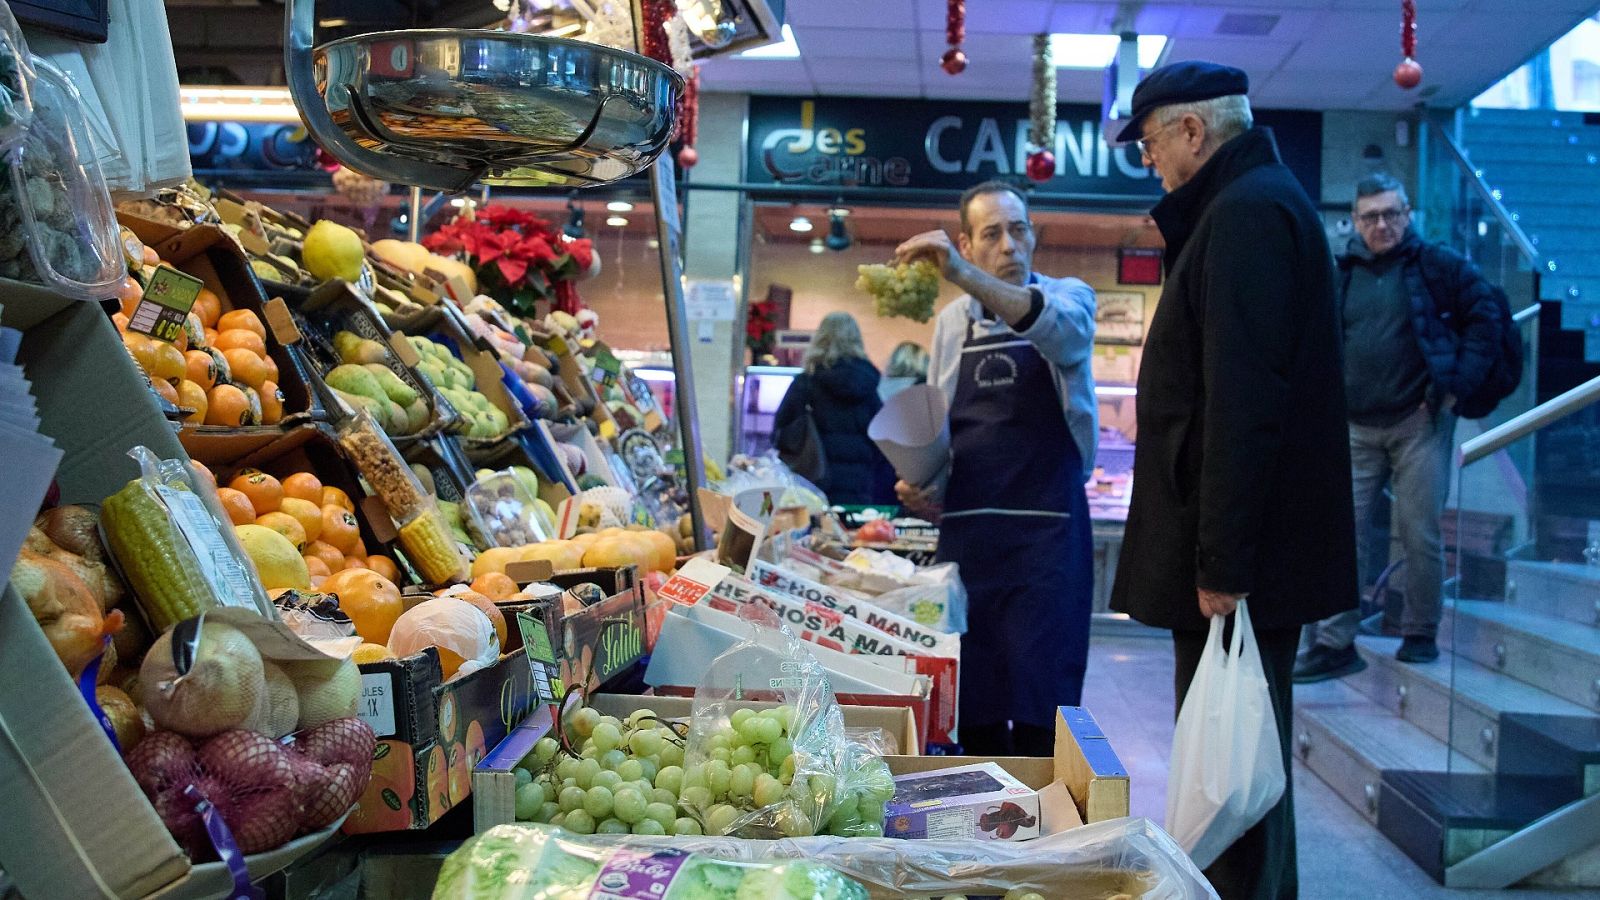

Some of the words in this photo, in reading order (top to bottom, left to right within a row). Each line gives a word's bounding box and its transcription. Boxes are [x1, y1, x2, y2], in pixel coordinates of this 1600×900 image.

[761, 129, 912, 186] Carne
[602, 610, 641, 676] Lolita
[828, 625, 846, 643] A
[843, 604, 858, 619] A
[865, 611, 937, 649] MANO
